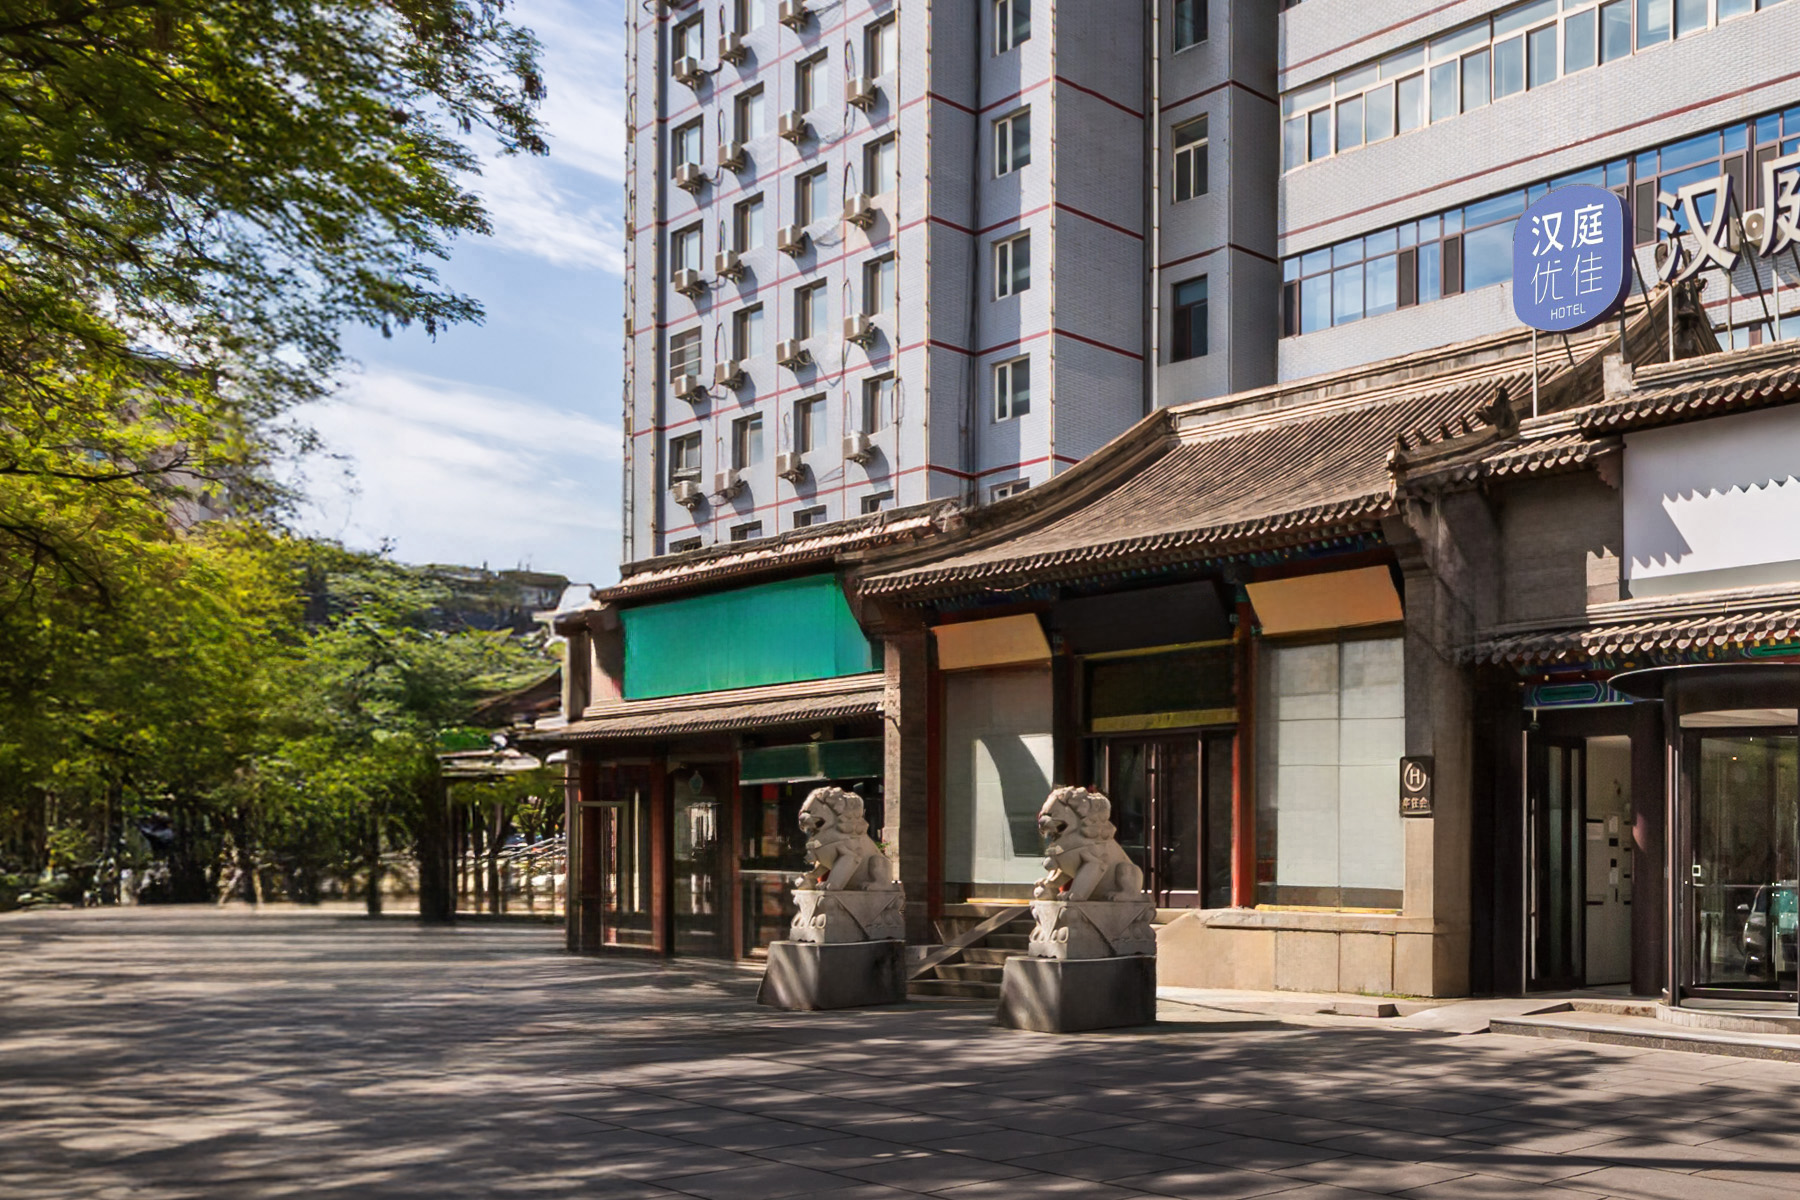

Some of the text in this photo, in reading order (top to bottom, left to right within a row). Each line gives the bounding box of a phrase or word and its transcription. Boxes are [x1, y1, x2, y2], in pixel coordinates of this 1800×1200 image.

[1531, 203, 1604, 257] 汉庭
[1530, 251, 1603, 305] 优佳
[1550, 302, 1587, 321] HOTEL
